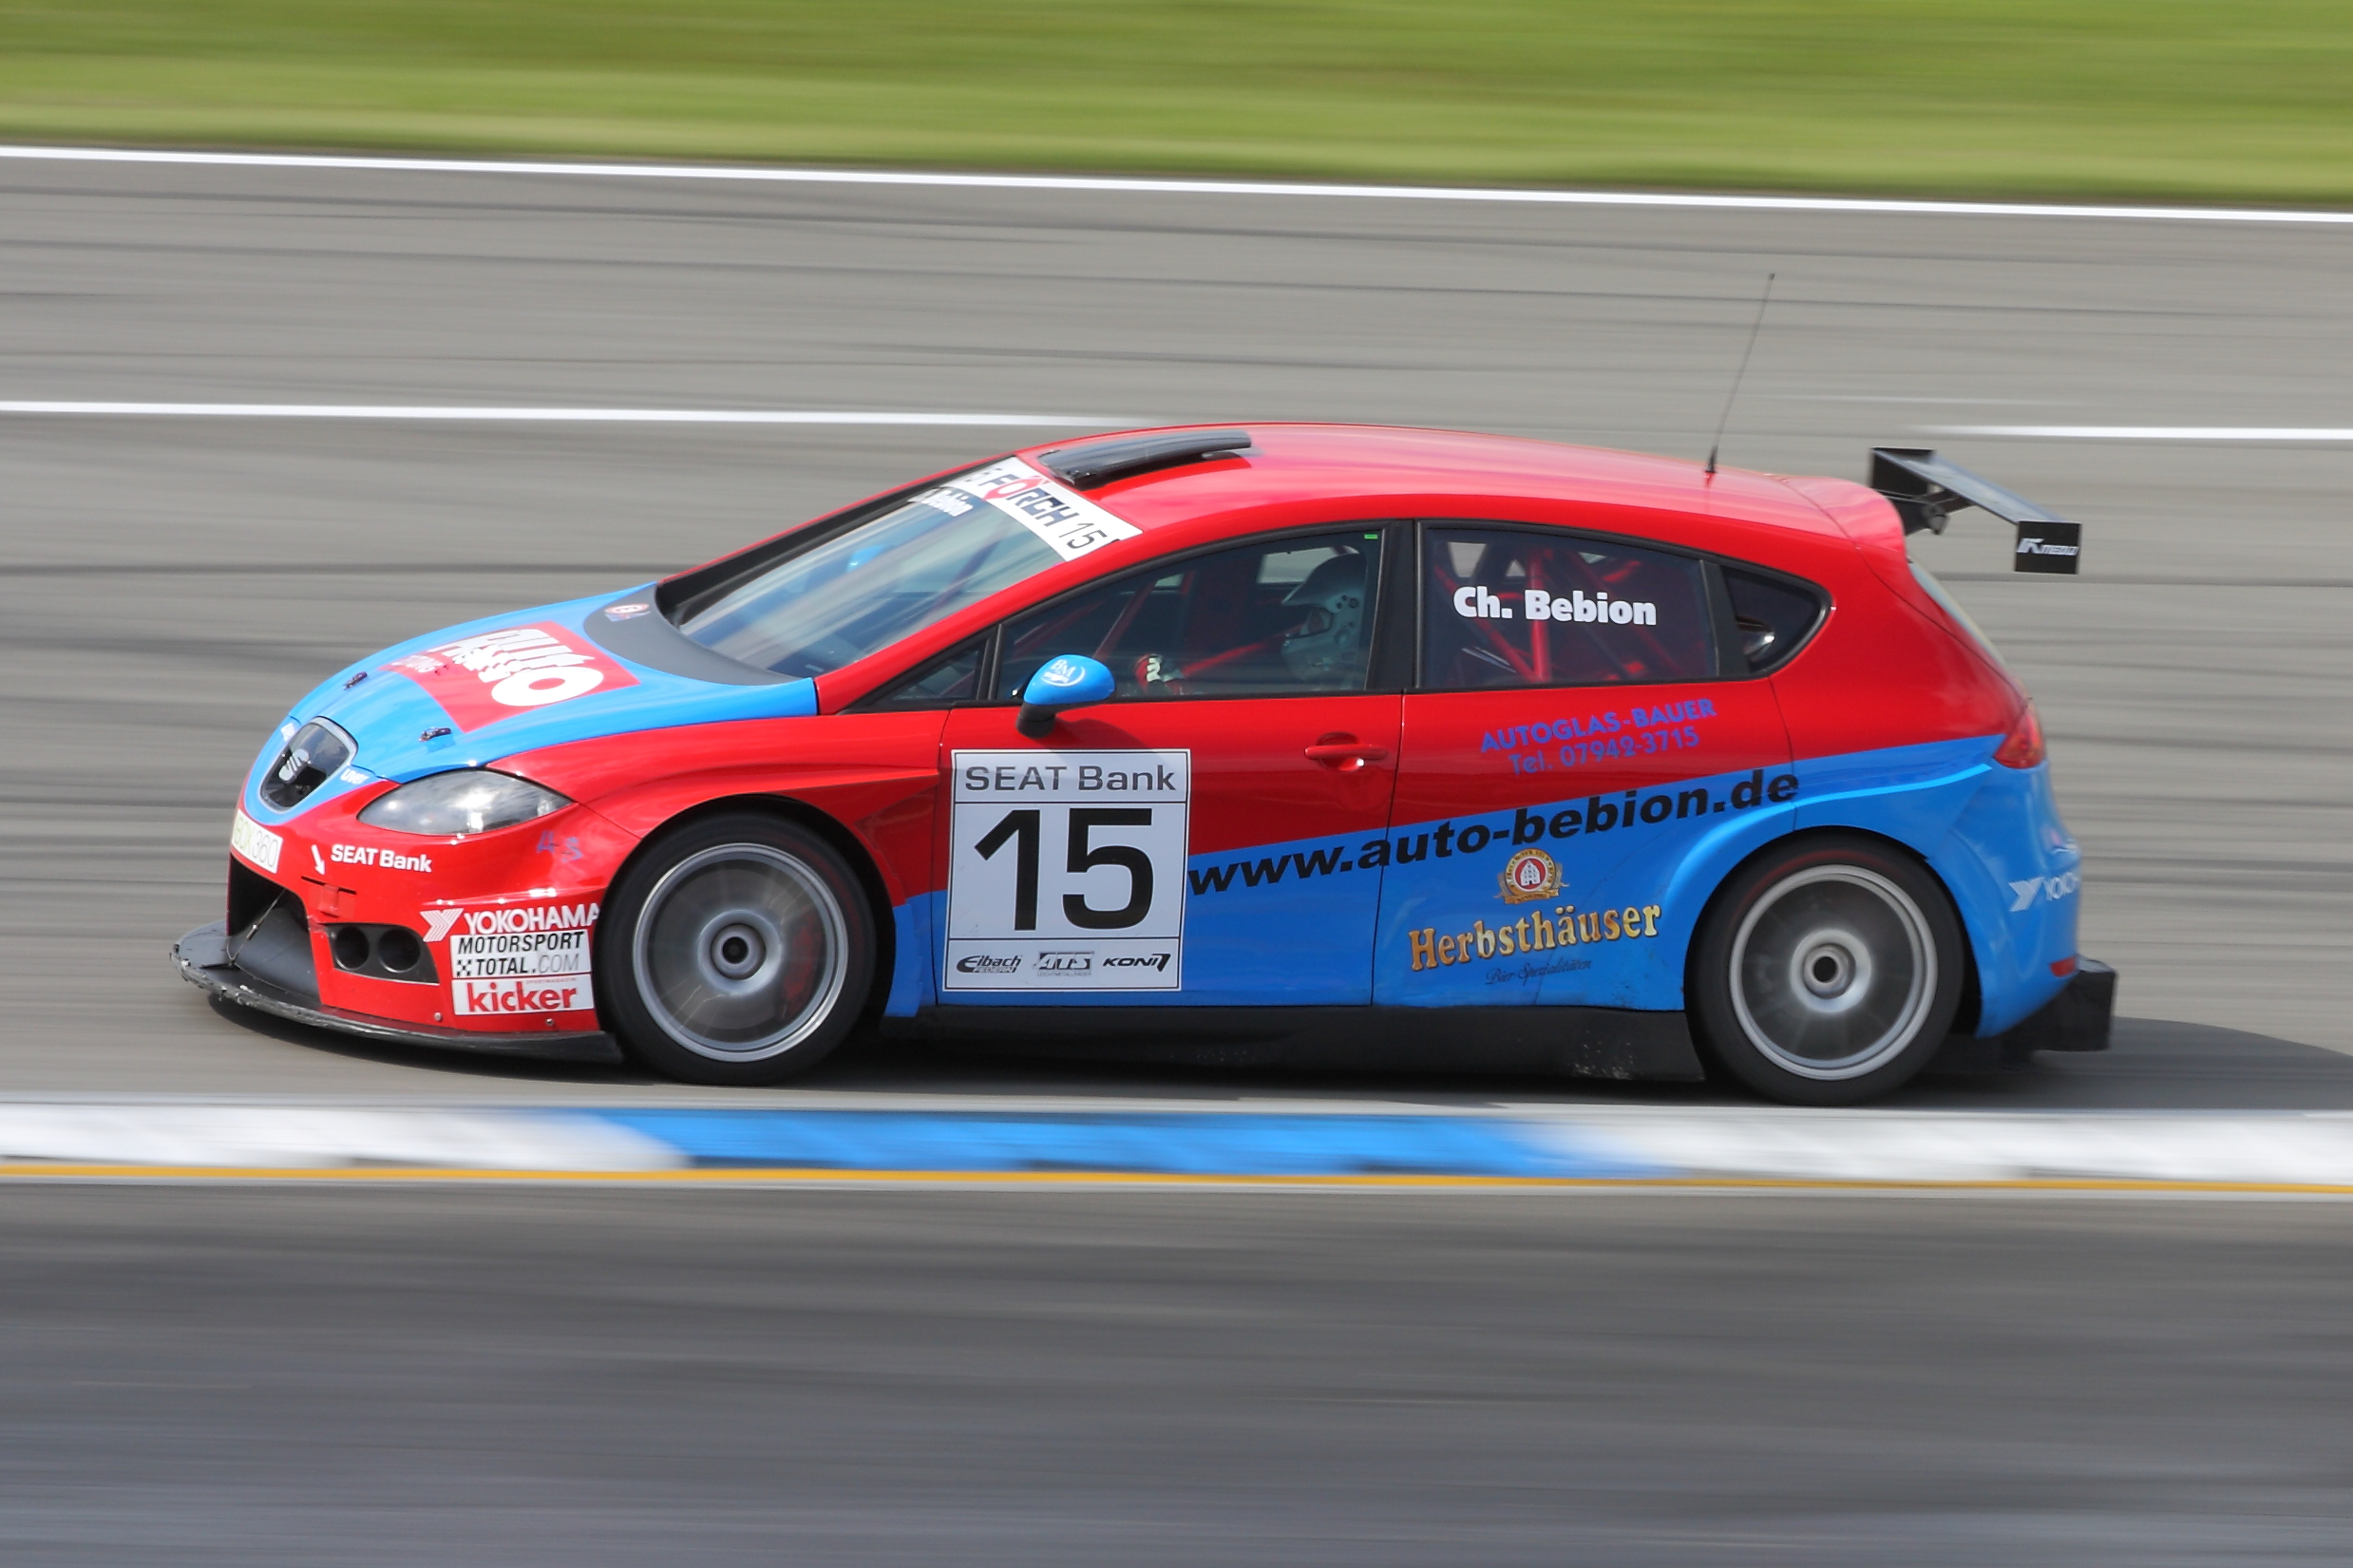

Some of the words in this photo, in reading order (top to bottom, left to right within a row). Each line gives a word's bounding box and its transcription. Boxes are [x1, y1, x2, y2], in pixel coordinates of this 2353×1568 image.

[1058, 521, 1108, 550] 15
[1453, 585, 1513, 619] Ch.
[1525, 589, 1657, 626] Bebion
[1480, 698, 1717, 753] AUTOGLAS-BAUER
[1508, 749, 1553, 775] Tel.
[1560, 726, 1700, 767] 07942-3715
[965, 765, 1067, 791] SEAT
[1078, 765, 1177, 791] Bank
[1188, 768, 1799, 896] www.auto-bebion.de
[331, 844, 379, 866] SEAT
[380, 851, 432, 873] Bank
[974, 807, 1154, 932] 15
[464, 902, 600, 935] YOKOHAMA
[458, 931, 585, 955] MOTORSPORT
[1408, 903, 1662, 973] Herbsthäuser
[476, 954, 580, 976] TOTAL.COM
[956, 954, 1022, 973] Eibach
[1033, 951, 1095, 970] ATS
[1103, 953, 1171, 973] KONI
[466, 981, 578, 1012] kicker
